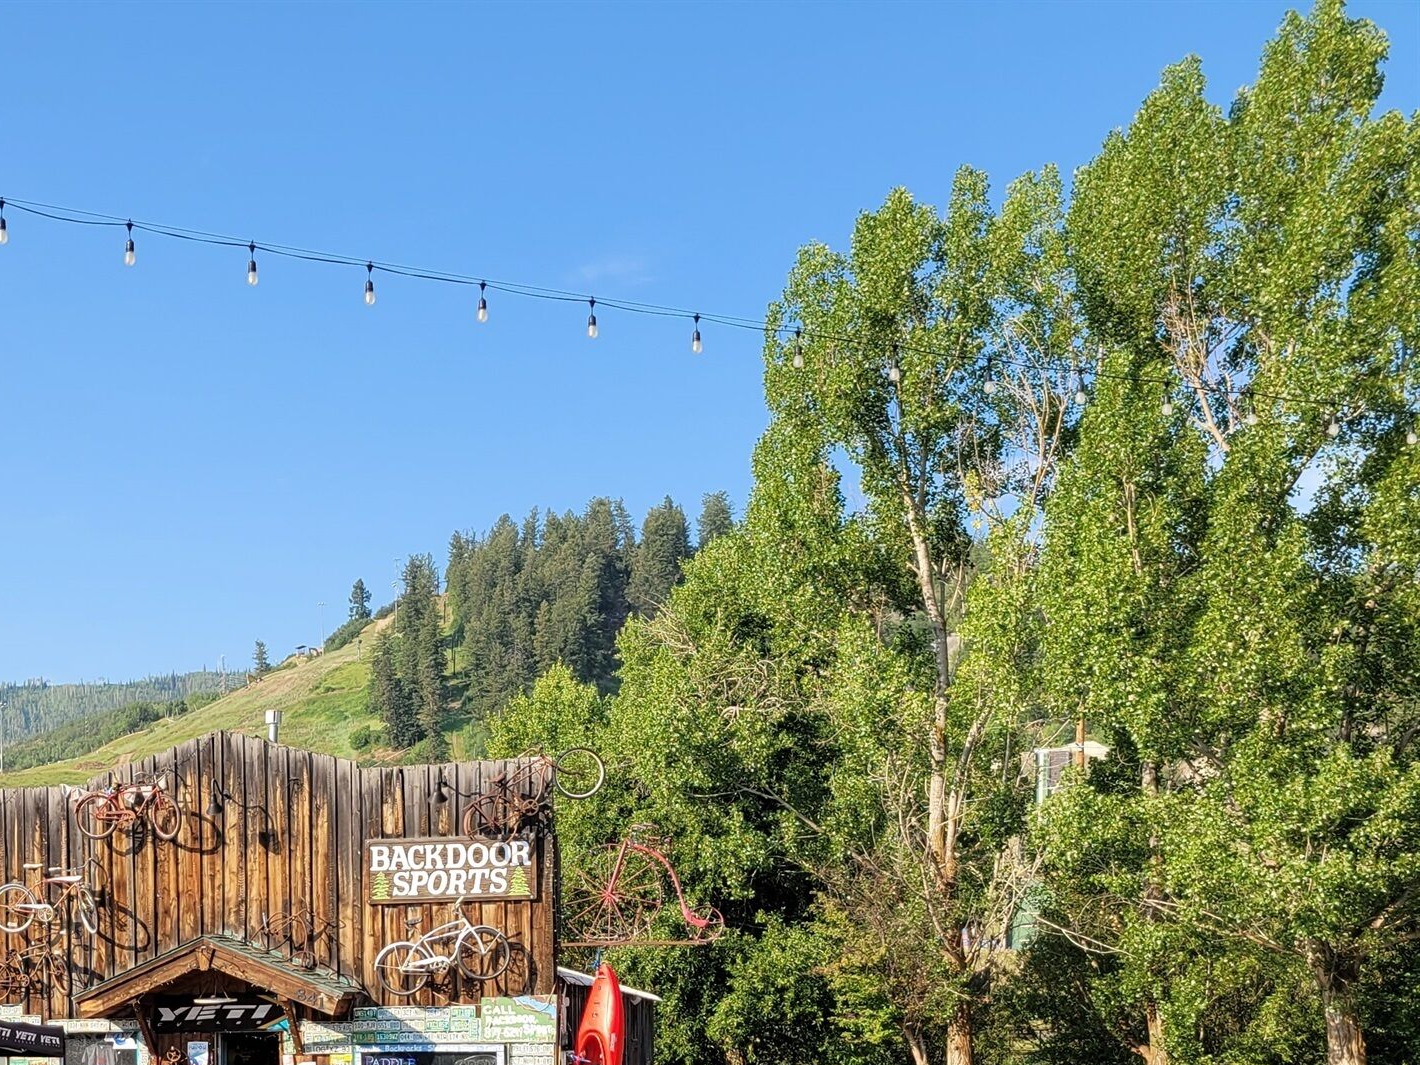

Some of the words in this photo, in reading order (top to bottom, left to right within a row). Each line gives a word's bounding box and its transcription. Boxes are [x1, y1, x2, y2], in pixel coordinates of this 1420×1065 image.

[370, 841, 532, 871] BACKDOOR
[392, 868, 508, 897] SPORTS
[297, 989, 325, 1010] 841
[157, 1004, 273, 1022] YETI
[482, 1004, 516, 1015] CALL
[15, 1029, 37, 1042] YETI
[40, 1034, 60, 1045] YETI
